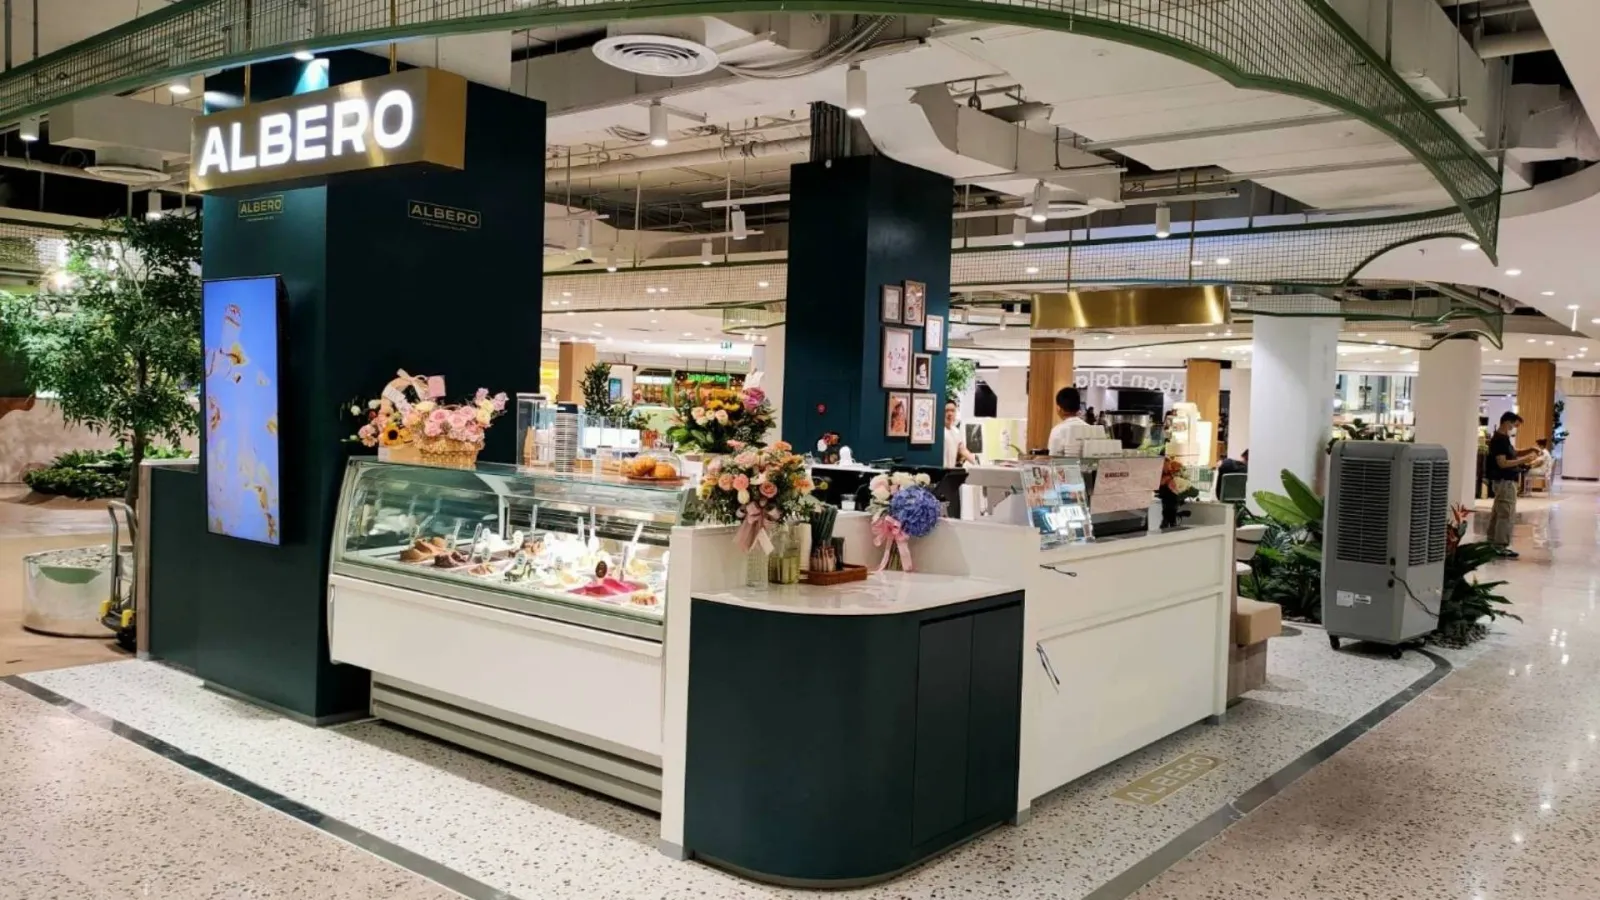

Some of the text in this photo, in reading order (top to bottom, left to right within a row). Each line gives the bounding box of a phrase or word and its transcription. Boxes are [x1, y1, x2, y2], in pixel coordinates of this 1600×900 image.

[198, 90, 413, 176] ALBERO
[240, 199, 281, 214] ALBERO
[411, 204, 478, 225] ALBERO
[1127, 757, 1214, 802] ALBERO
